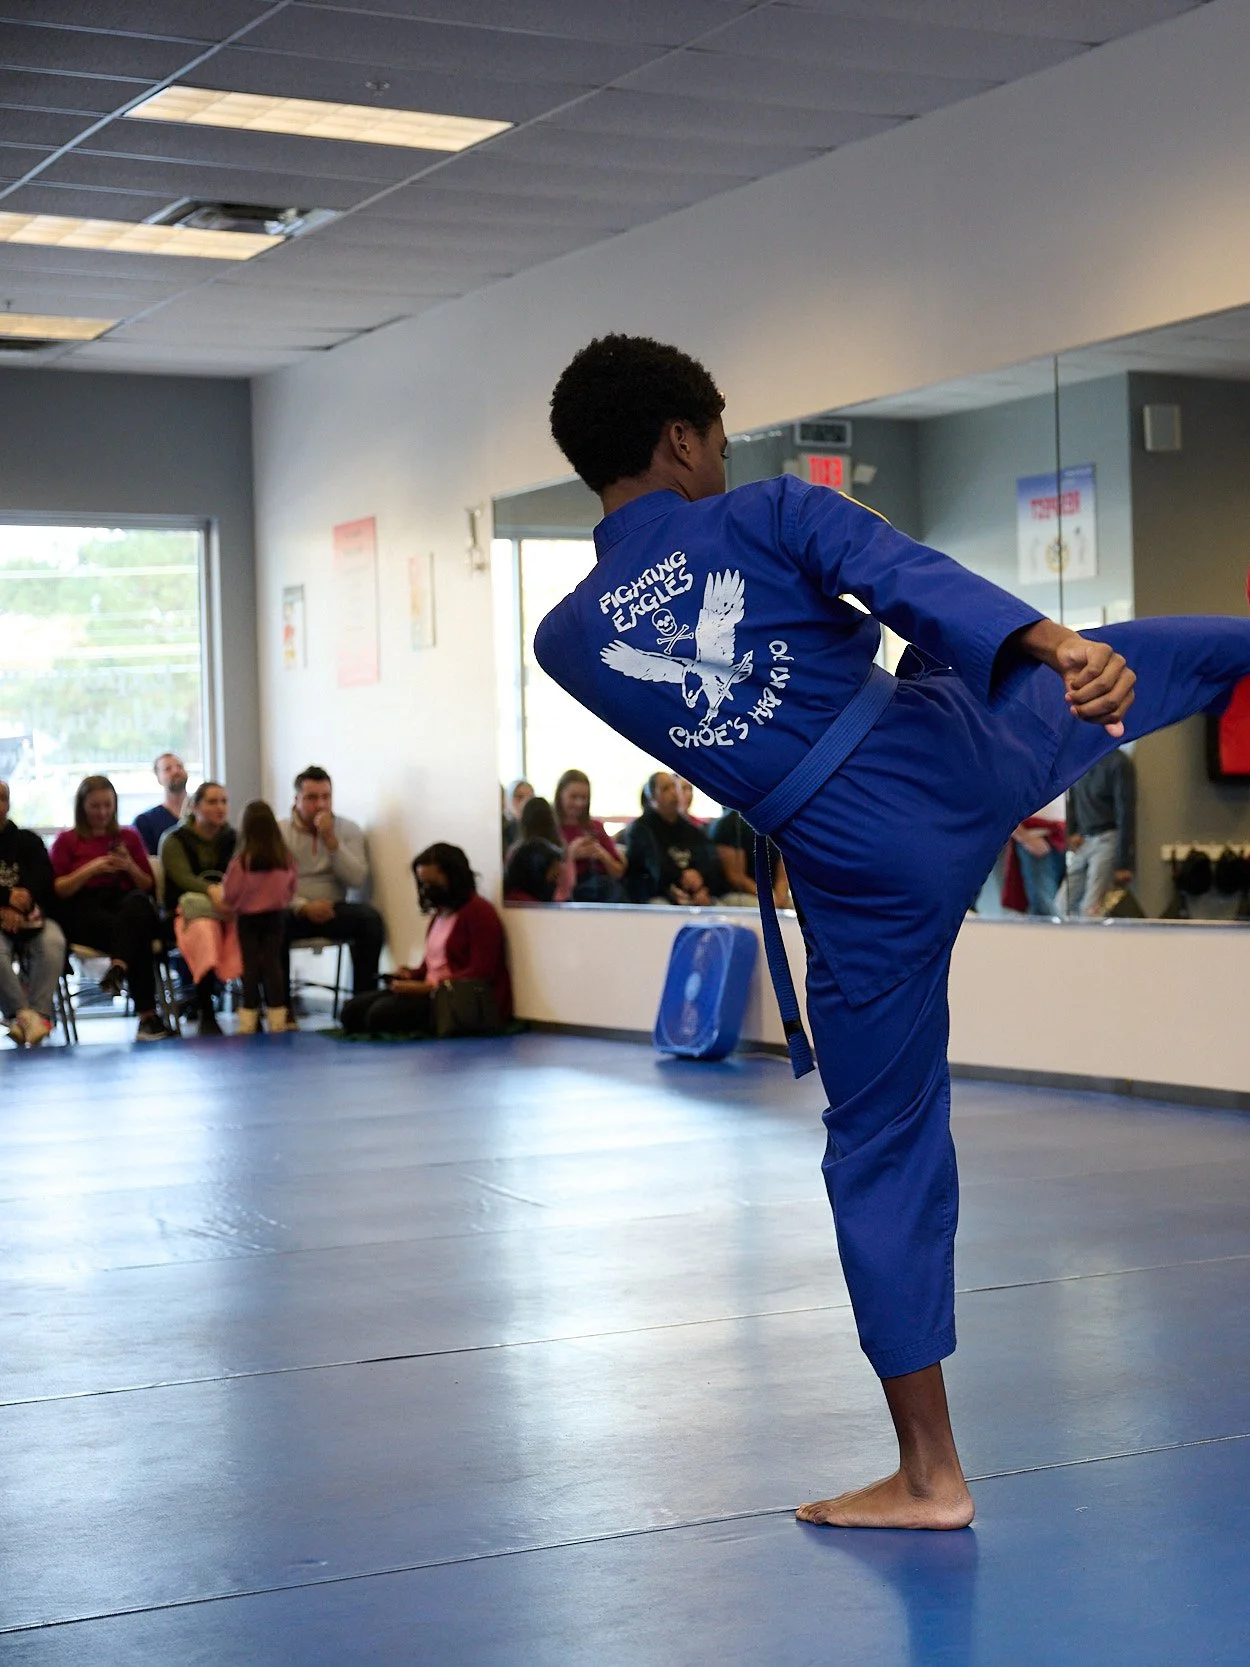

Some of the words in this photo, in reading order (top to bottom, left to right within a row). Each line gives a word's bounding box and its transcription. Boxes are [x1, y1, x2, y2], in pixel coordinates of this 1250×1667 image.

[599, 551, 687, 614] FIGHTING
[612, 567, 694, 633] EAGLES
[668, 716, 749, 748] CHOE'S
